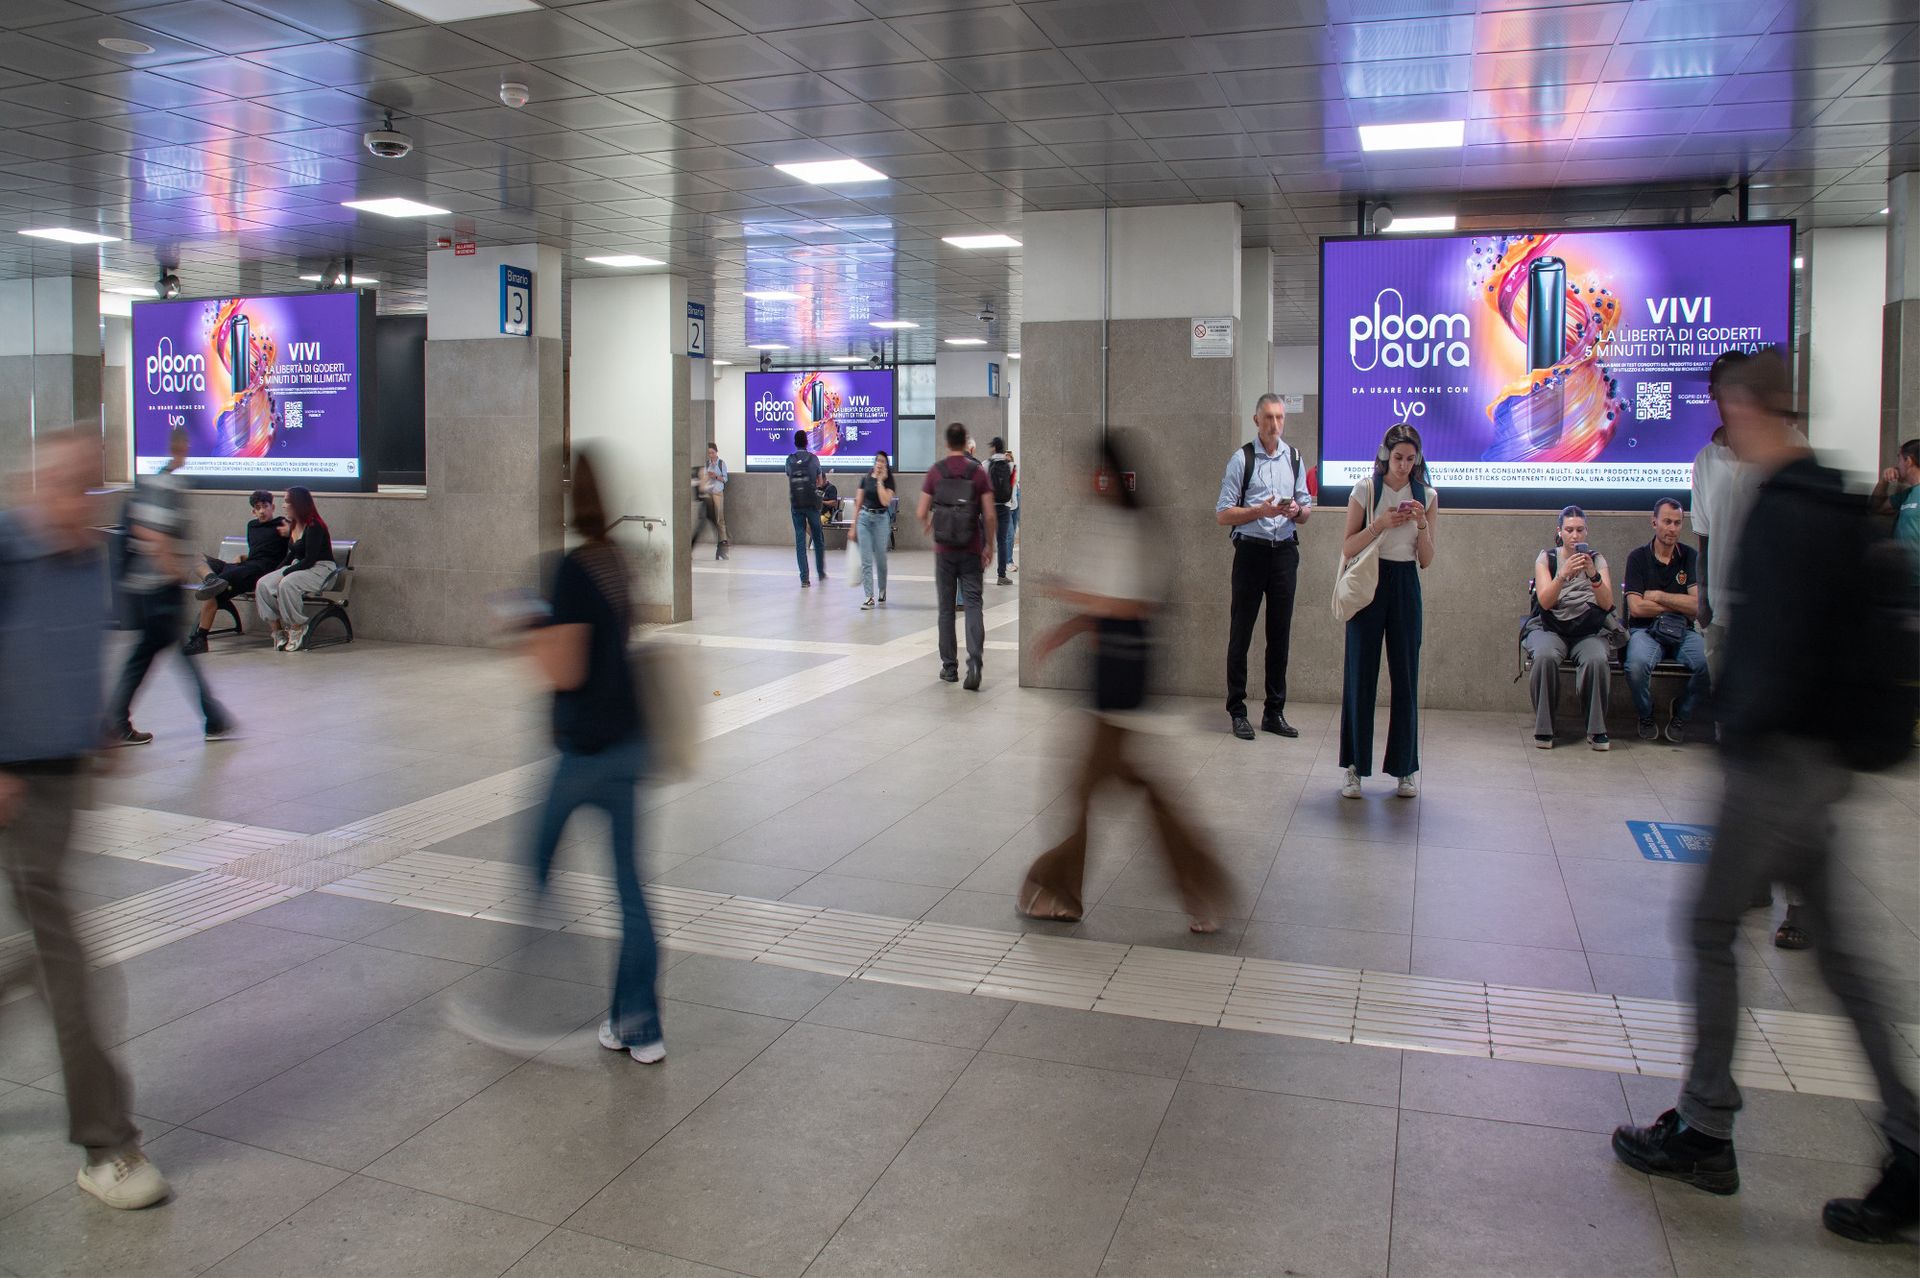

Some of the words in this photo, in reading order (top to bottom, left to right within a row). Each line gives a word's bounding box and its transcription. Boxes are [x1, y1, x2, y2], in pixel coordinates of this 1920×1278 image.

[507, 270, 528, 285] Binario
[513, 292, 523, 325] 3
[1646, 297, 1712, 324] VIVI
[1349, 288, 1471, 359] ploom
[691, 322, 700, 349] 2
[1599, 330, 1616, 342] LA
[1620, 326, 1675, 342] LIBERTÀ
[1679, 329, 1693, 341] DI
[1696, 327, 1761, 341] GODERTI
[288, 342, 321, 361] VIVI
[1381, 341, 1470, 368] aura
[1584, 345, 1593, 357] 5
[1596, 344, 1647, 357] MINUTI
[1651, 344, 1665, 356] DI
[1668, 343, 1695, 356] TIRI
[147, 337, 206, 388] ploom
[266, 366, 274, 375] LA
[275, 363, 303, 374] LIBERTÀ
[304, 365, 312, 373] DI
[313, 363, 345, 373] GODERTI
[162, 374, 206, 393] aura
[265, 374, 290, 385] MINUTI
[291, 374, 298, 383] DI
[299, 374, 312, 383] TIRI
[755, 391, 795, 418] ploom
[848, 395, 870, 406] VIVI
[765, 411, 795, 422] aura
